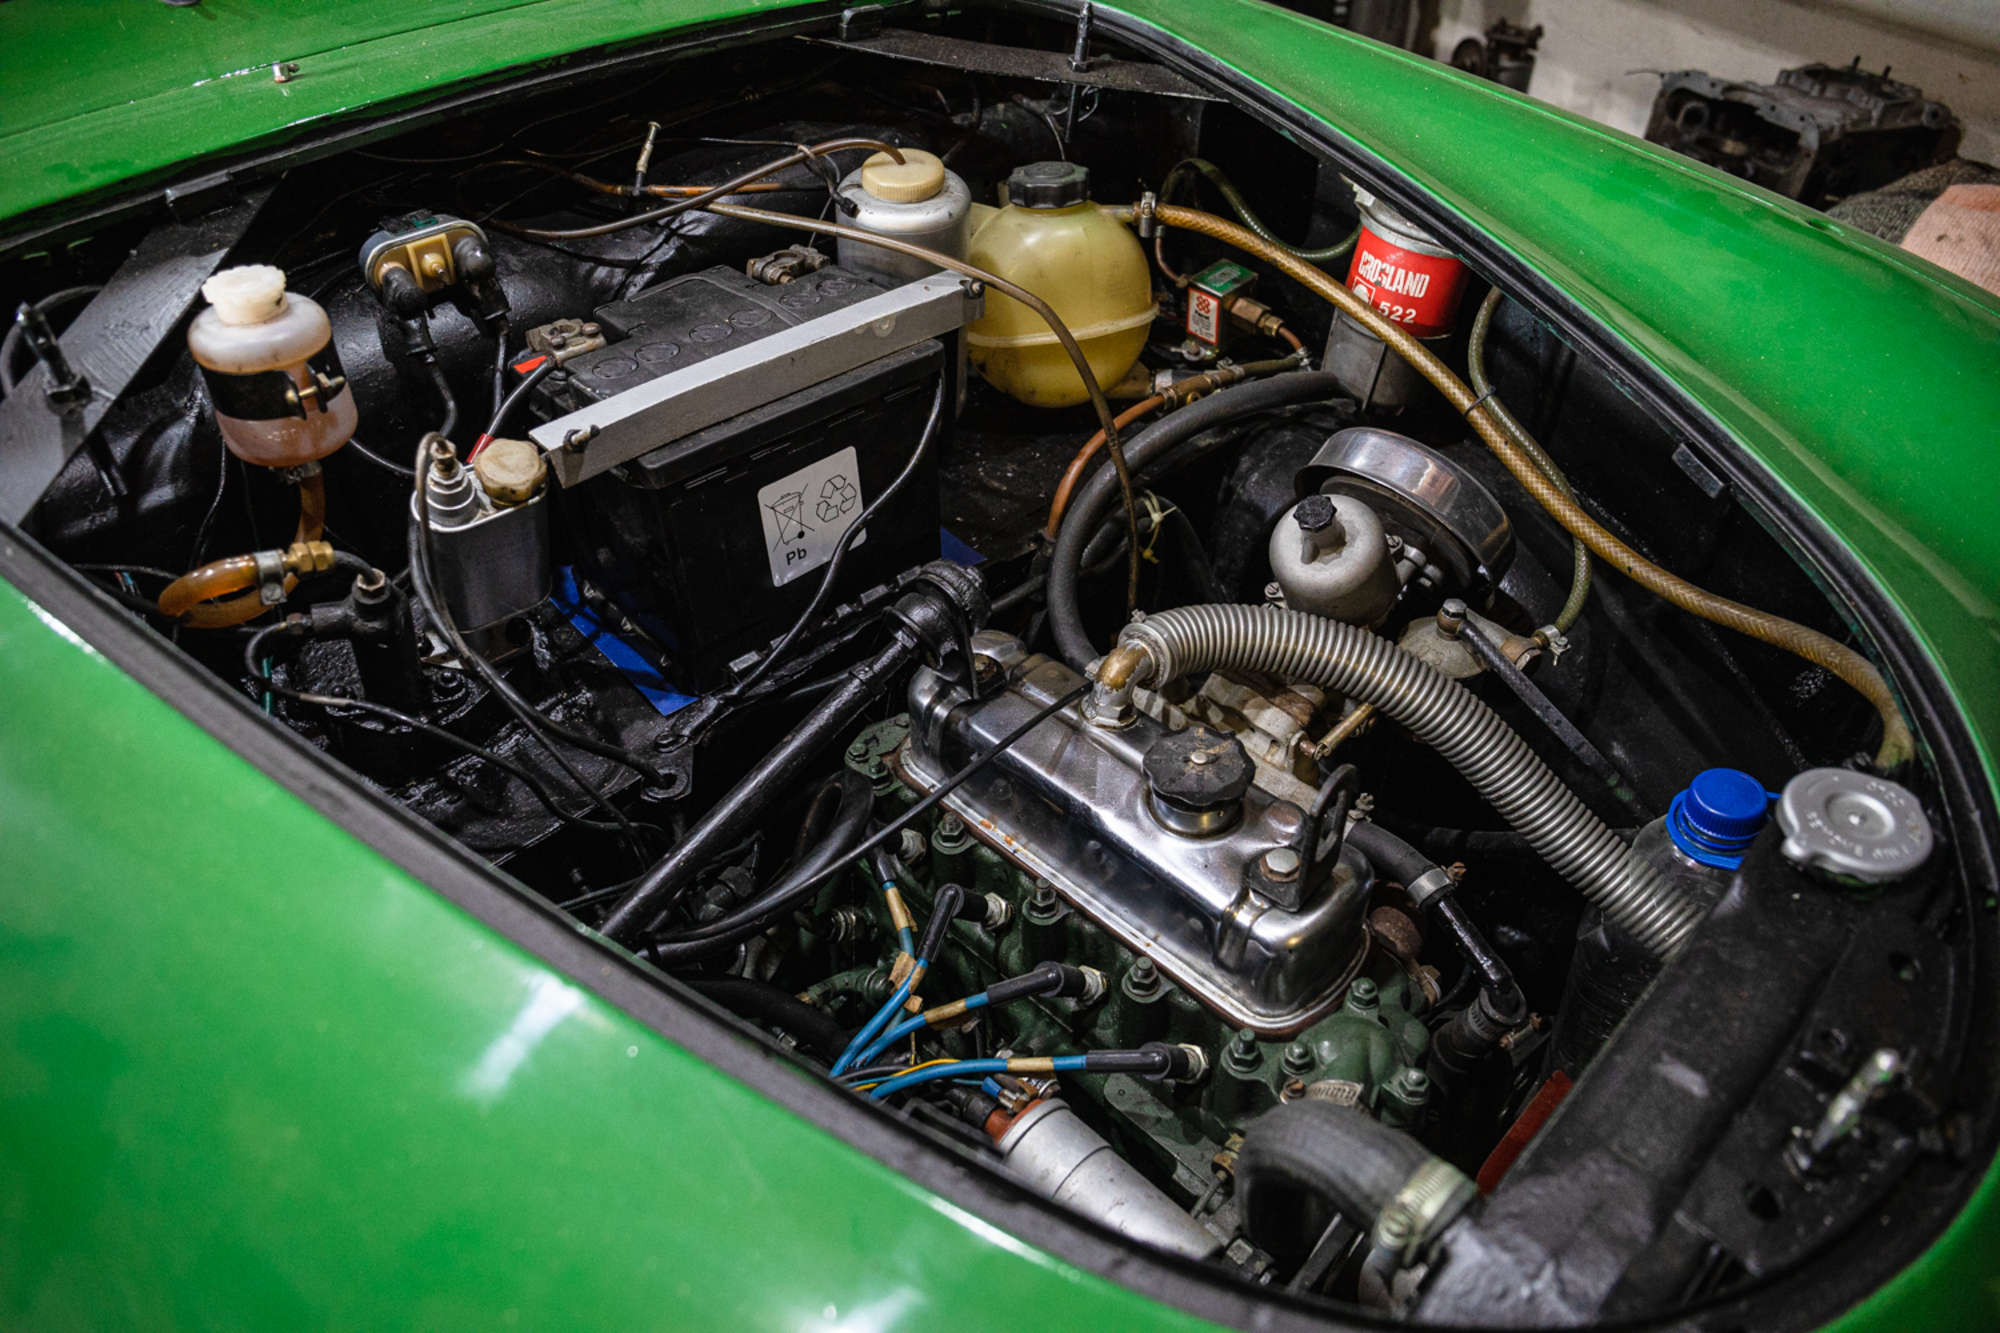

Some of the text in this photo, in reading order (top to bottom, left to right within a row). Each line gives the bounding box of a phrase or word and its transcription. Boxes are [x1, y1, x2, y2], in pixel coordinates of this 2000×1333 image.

[1358, 250, 1430, 298] CROSLAND
[1379, 301, 1417, 323] 522
[786, 547, 808, 566] Pb
